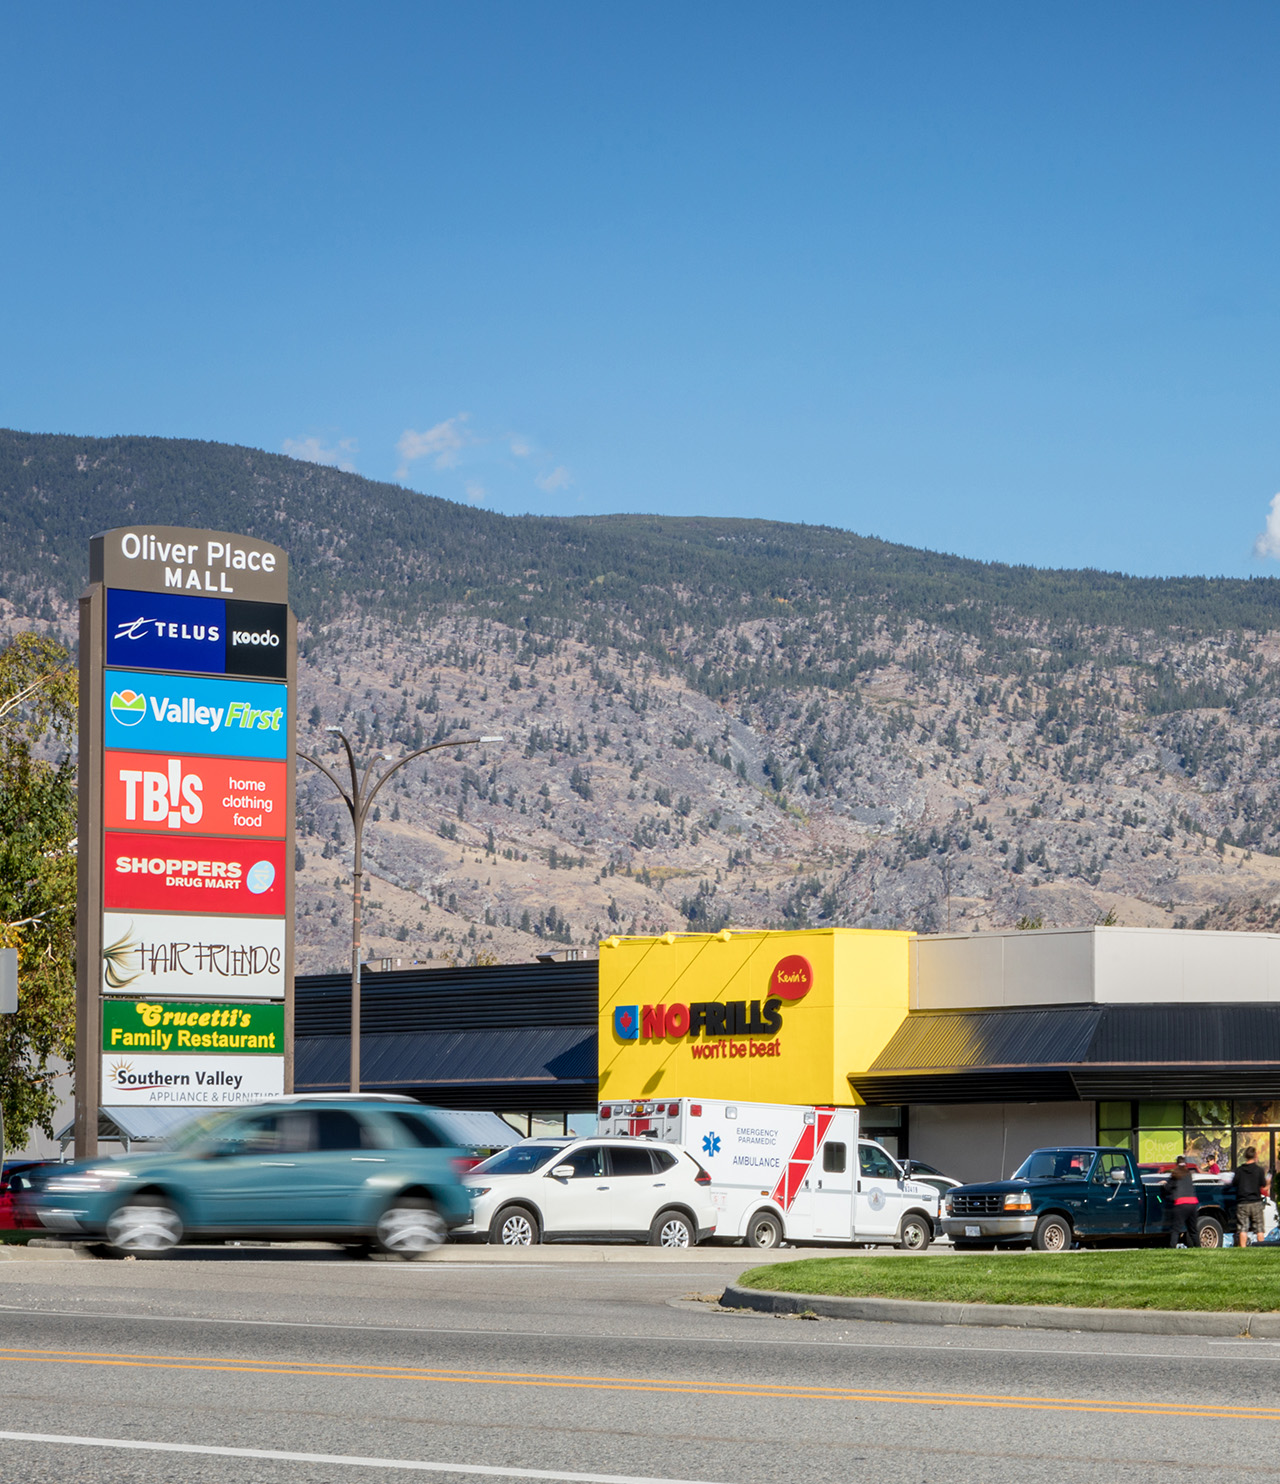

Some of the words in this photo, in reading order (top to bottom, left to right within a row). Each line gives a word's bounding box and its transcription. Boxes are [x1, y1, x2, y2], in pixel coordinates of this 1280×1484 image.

[121, 533, 198, 564] Oliver
[207, 542, 276, 572] Place
[164, 567, 234, 593] MALL
[154, 622, 220, 642] TELUS
[229, 777, 266, 791] home
[119, 759, 204, 829] TB!S
[222, 796, 273, 813] clothing
[233, 814, 262, 827] food
[115, 856, 242, 878] SHOPPERS
[166, 877, 203, 888] DRUG
[205, 878, 242, 890] MART
[134, 941, 193, 976] HAIR
[193, 941, 281, 977] FRIENDS
[776, 969, 807, 984] Kevin's
[110, 1028, 173, 1050] Family
[177, 1030, 276, 1049] Restaurant
[691, 1039, 727, 1060] won't
[729, 1039, 747, 1057] be
[749, 1038, 781, 1057] beat
[117, 1069, 190, 1086] Southern
[195, 1070, 243, 1089] Valley
[149, 1091, 210, 1102] APPLIANCE
[211, 1091, 219, 1102] &
[736, 1127, 778, 1137] EMERGENCY
[738, 1136, 777, 1146] PARAMEDIC
[733, 1155, 780, 1168] AMBULANCE
